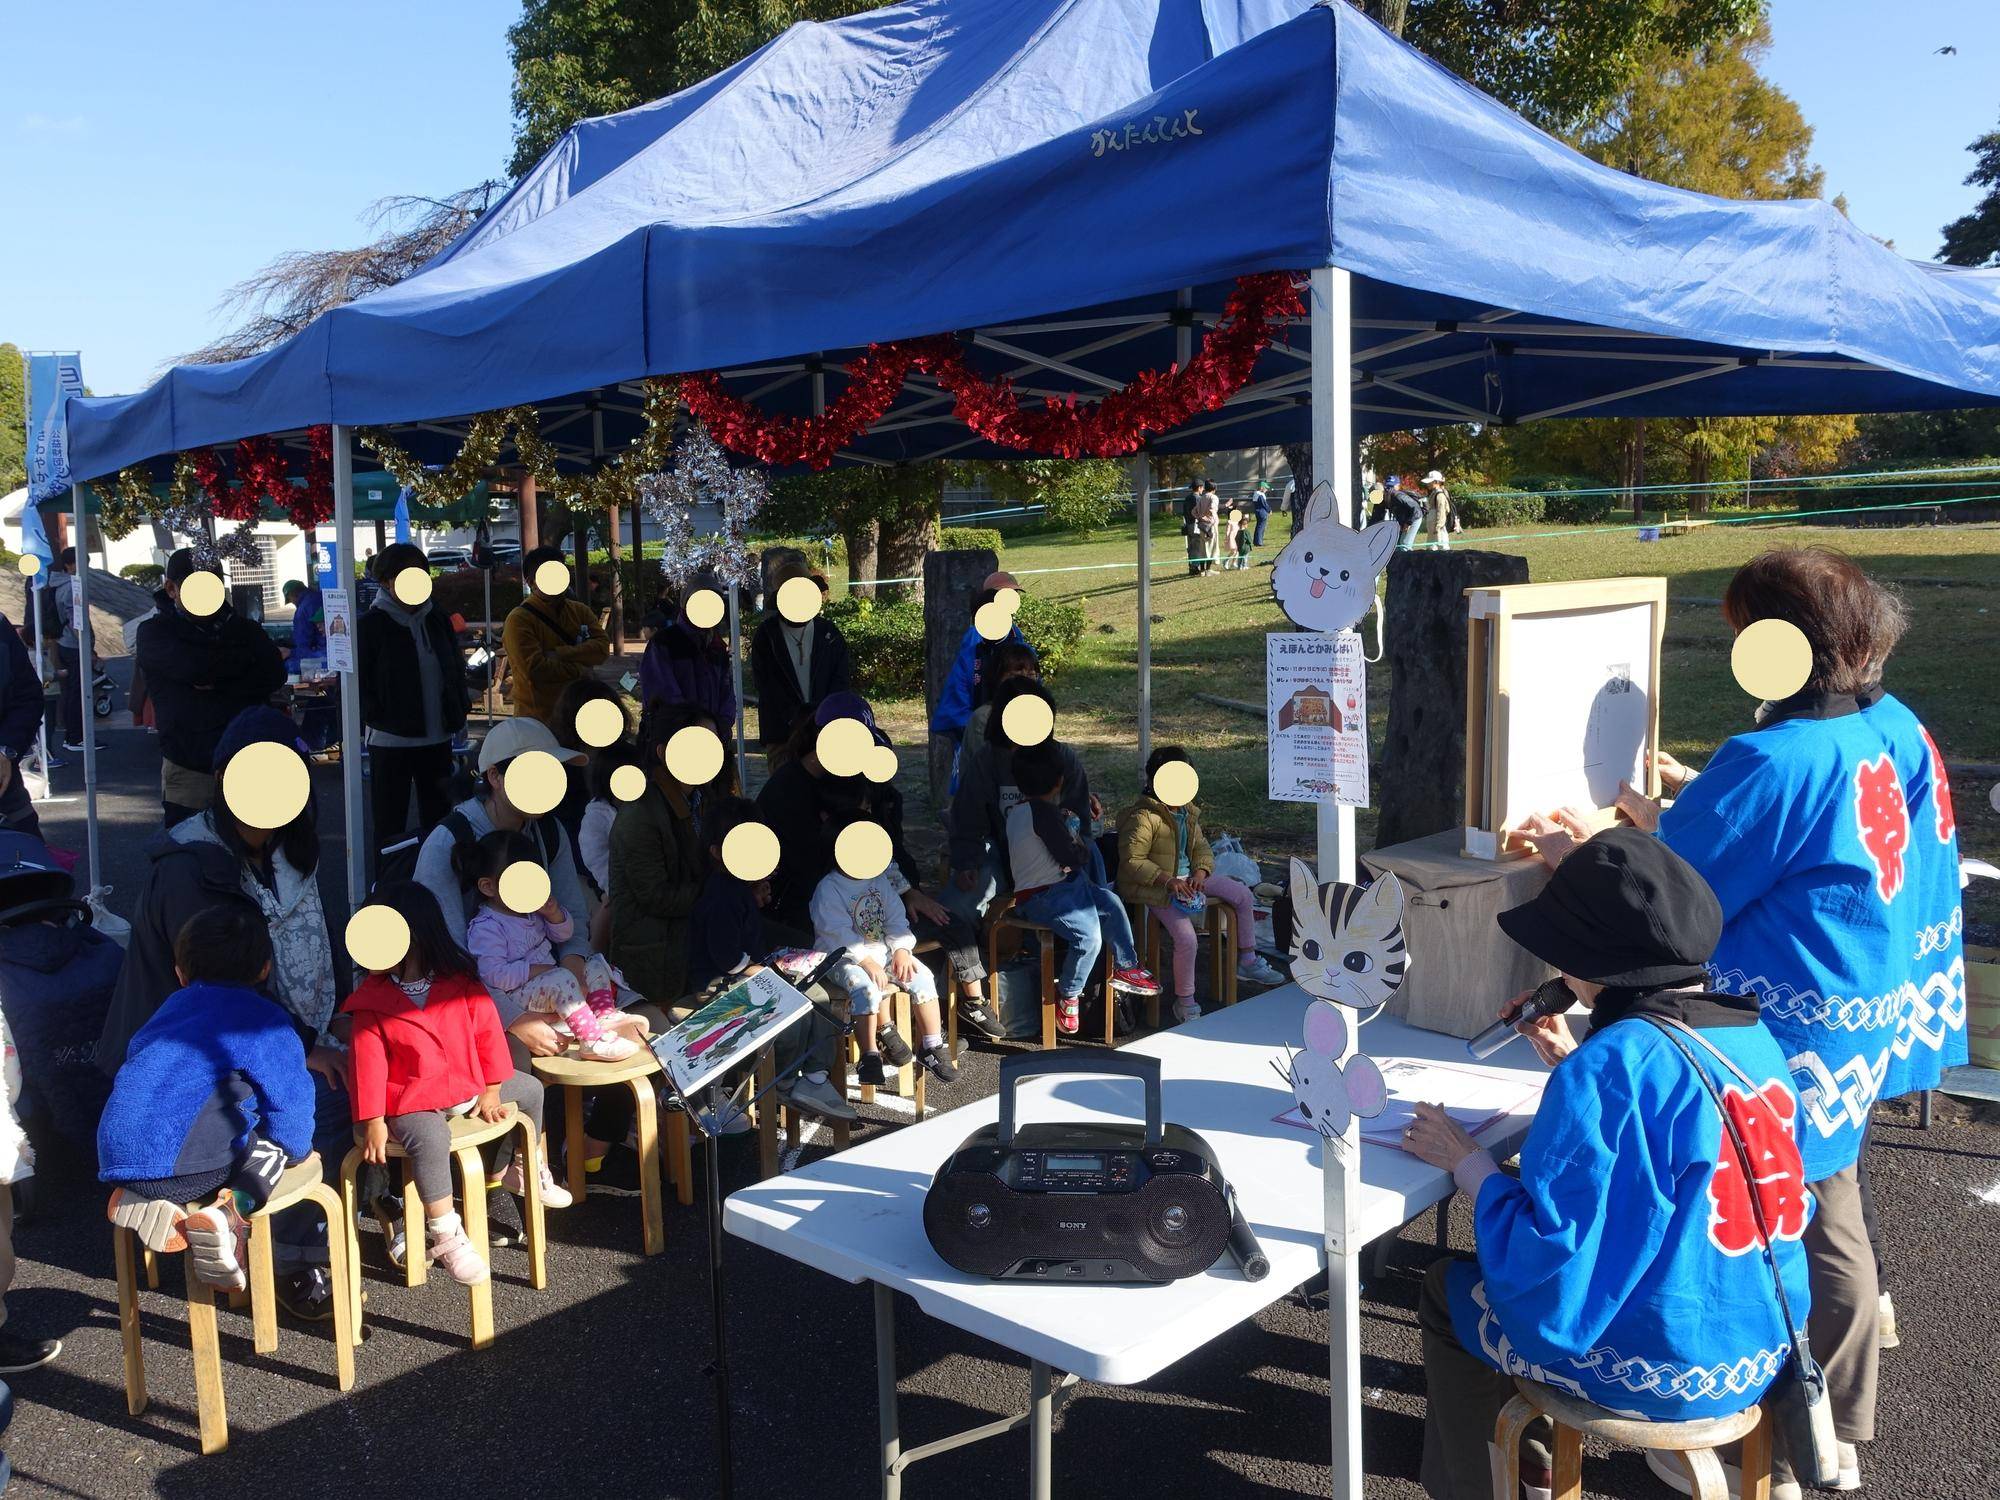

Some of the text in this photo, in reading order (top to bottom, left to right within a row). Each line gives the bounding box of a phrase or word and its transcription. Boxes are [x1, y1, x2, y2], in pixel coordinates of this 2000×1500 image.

[1091, 109, 1203, 158] かんたんてんと
[1279, 643, 1353, 655] えほんとかみしばい
[1059, 1221, 1087, 1229] SONY
